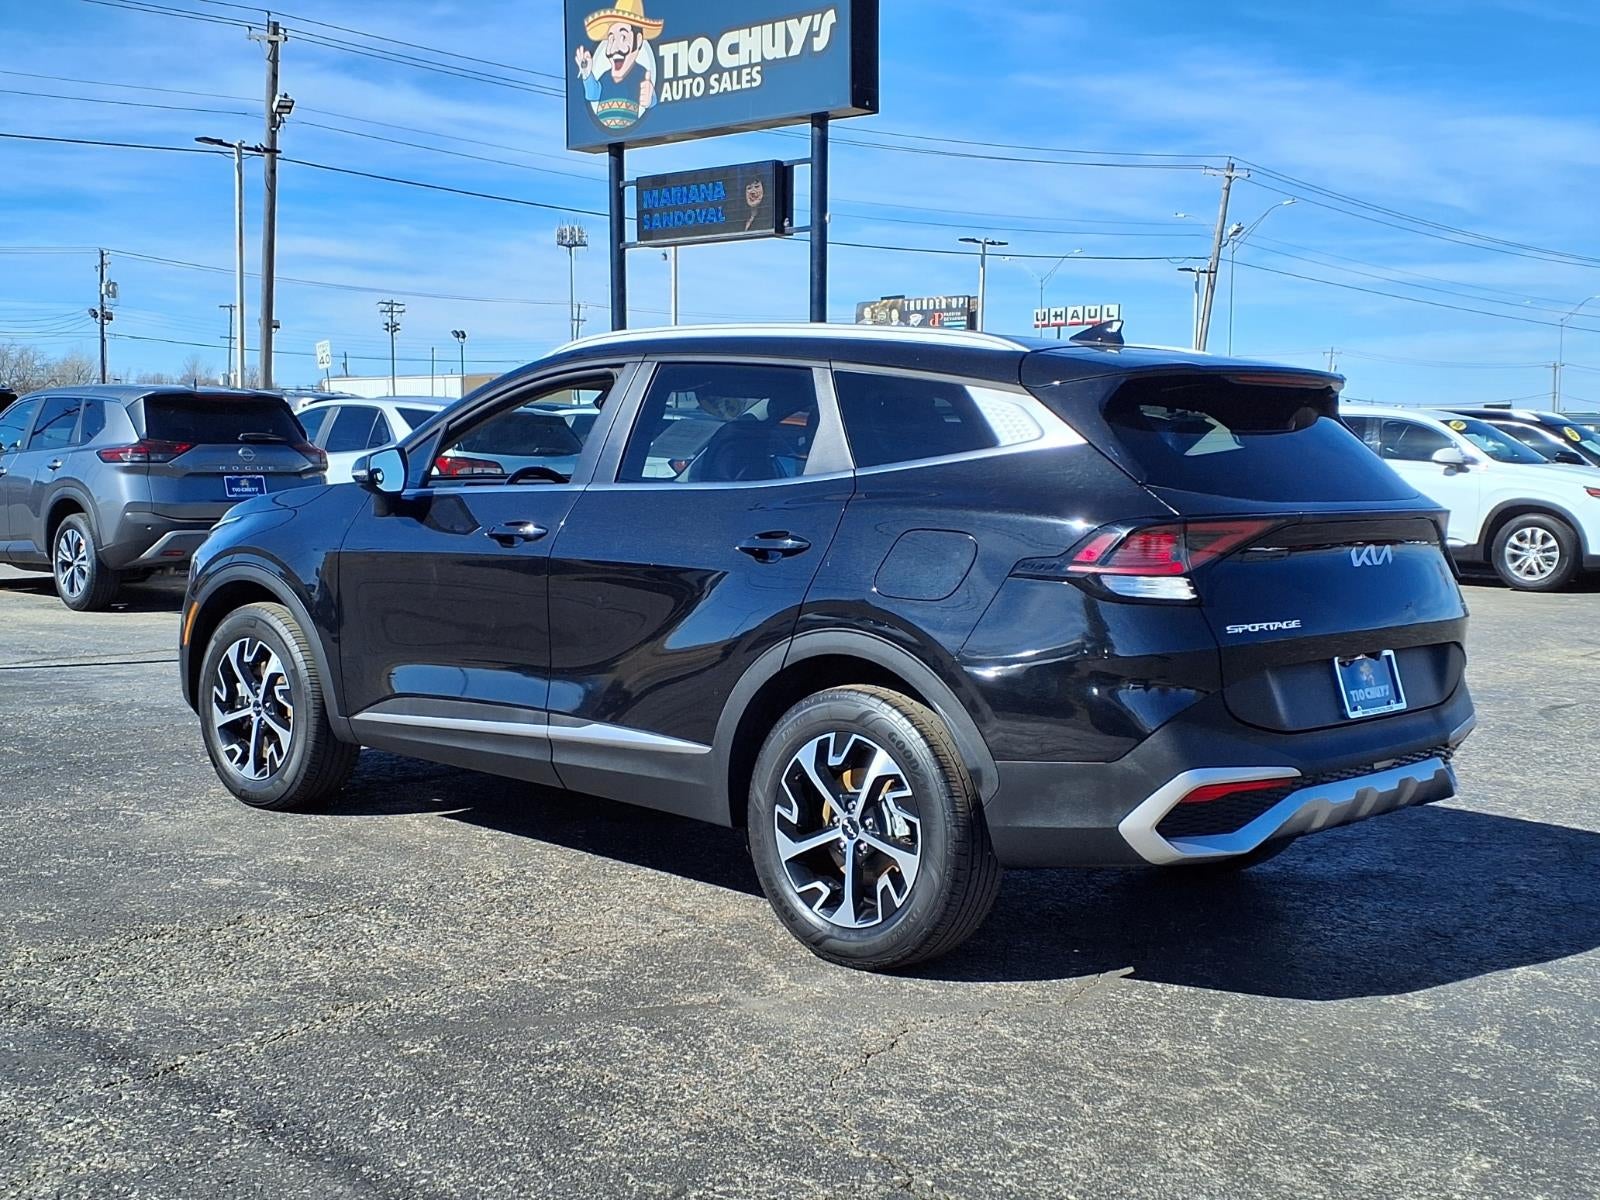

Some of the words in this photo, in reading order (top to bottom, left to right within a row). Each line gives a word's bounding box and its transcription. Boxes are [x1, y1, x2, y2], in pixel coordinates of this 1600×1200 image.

[658, 37, 714, 79] TIO
[716, 8, 837, 69] CHUY'S
[660, 77, 705, 103] AUTO
[709, 66, 763, 95] SALES
[642, 181, 726, 209] MARIANA
[642, 207, 726, 231] SANDOVAL
[904, 297, 947, 311] THUNDER
[1226, 619, 1302, 634] SPORTAGE
[1350, 688, 1365, 702] TIO
